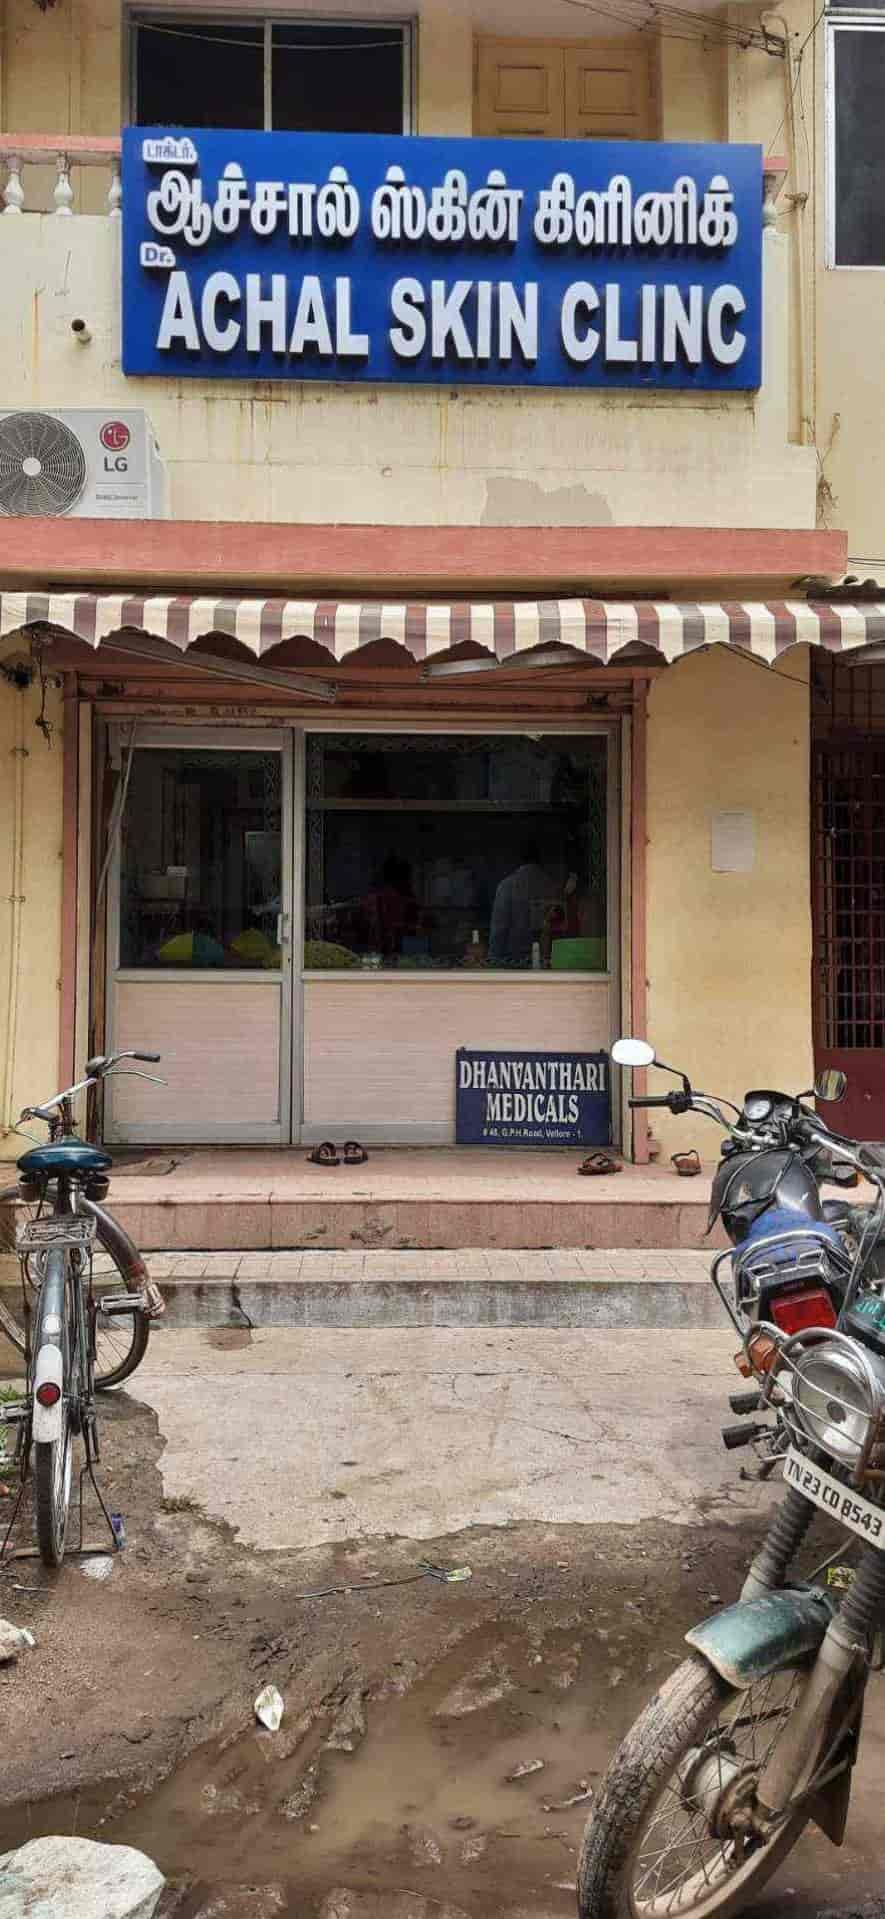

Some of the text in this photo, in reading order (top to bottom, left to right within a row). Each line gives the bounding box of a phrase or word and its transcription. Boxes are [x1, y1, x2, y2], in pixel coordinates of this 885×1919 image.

[147, 162, 739, 246] ஆச்சால் ஸ்கின் கிளினிக்
[144, 246, 173, 264] Dr.
[156, 271, 747, 365] ACHAL SKIN CLINC
[103, 456, 129, 472] LG
[459, 1061, 606, 1091] DHANVANTHARI
[486, 1092, 579, 1123] MEDICALS
[803, 1471, 821, 1496] 23
